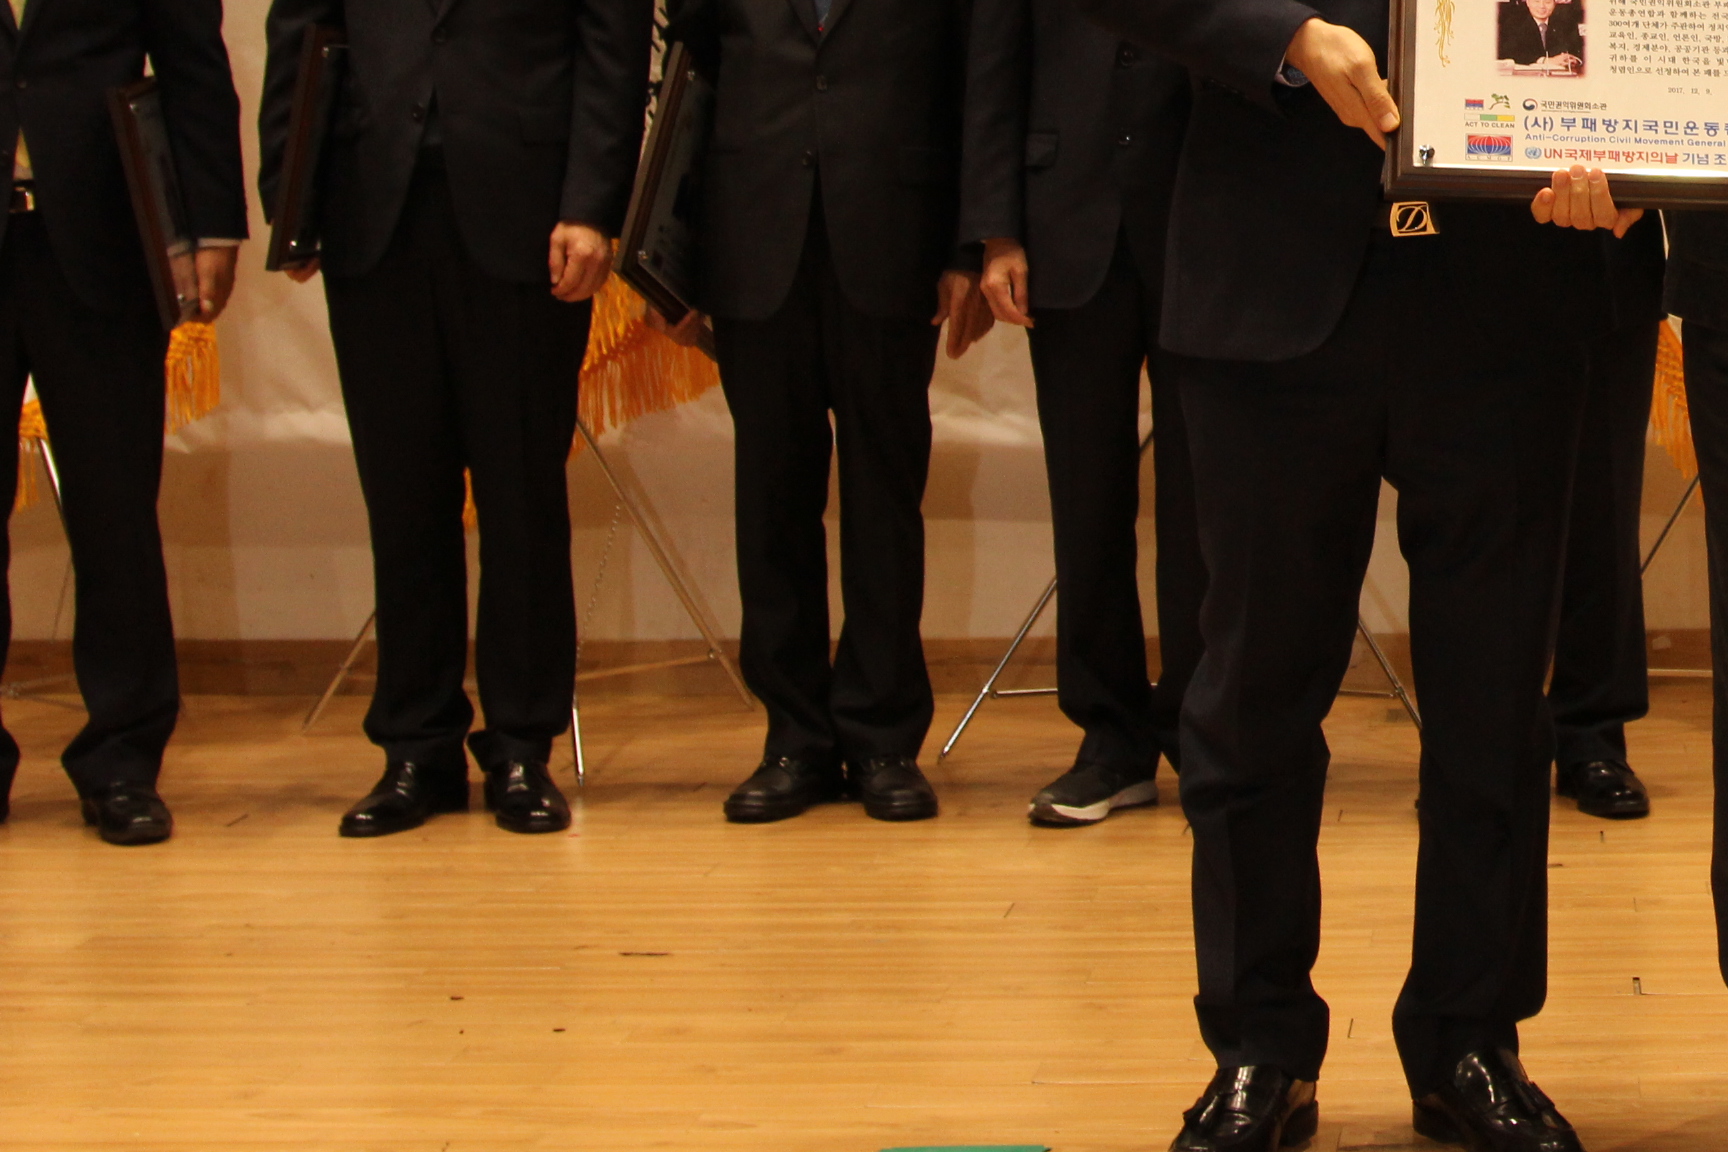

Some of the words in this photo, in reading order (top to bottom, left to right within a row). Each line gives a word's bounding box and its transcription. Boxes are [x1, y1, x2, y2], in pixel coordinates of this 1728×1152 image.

[1525, 133, 1606, 143] Anti-Corruption
[1609, 134, 1631, 144] Civil
[1634, 137, 1684, 146] Movement
[1688, 139, 1726, 147] General
[1682, 152, 1709, 166] 기념
